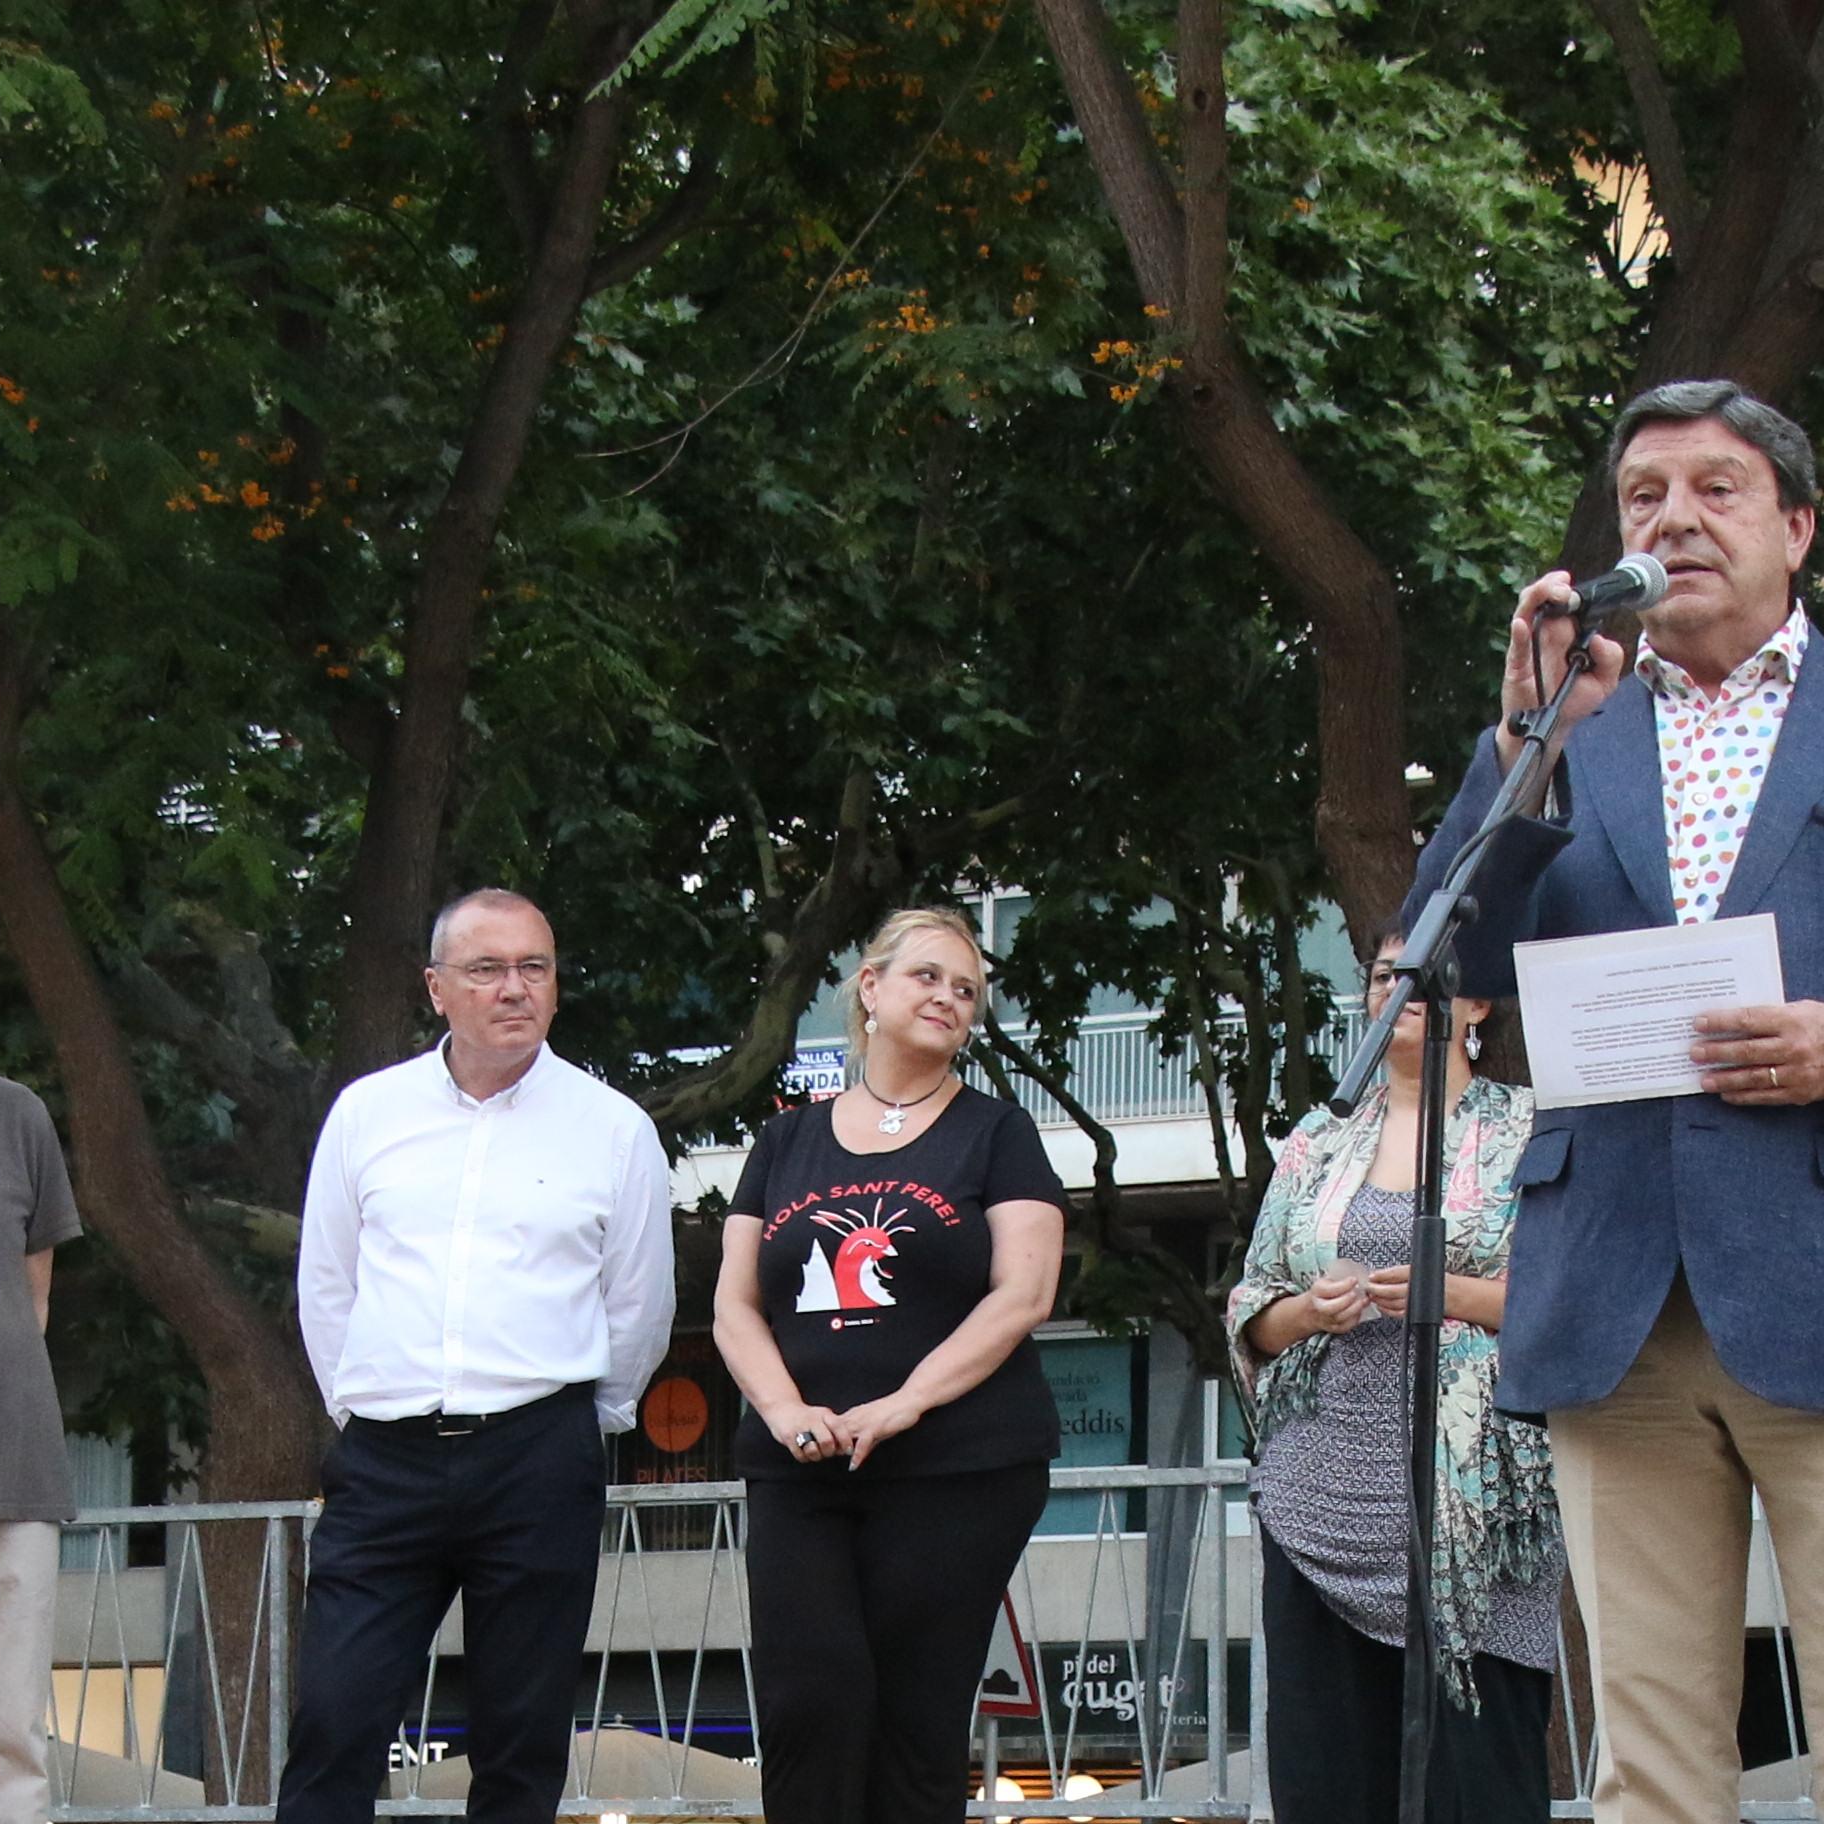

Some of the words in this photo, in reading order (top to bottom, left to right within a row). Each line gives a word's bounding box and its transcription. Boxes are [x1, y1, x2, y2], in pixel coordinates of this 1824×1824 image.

[763, 1191, 822, 1241] HOLA
[829, 1180, 900, 1199] SANT
[899, 1182, 961, 1227] PERE!
[1087, 1654, 1116, 1675] del
[1061, 1674, 1175, 1721] cugt
